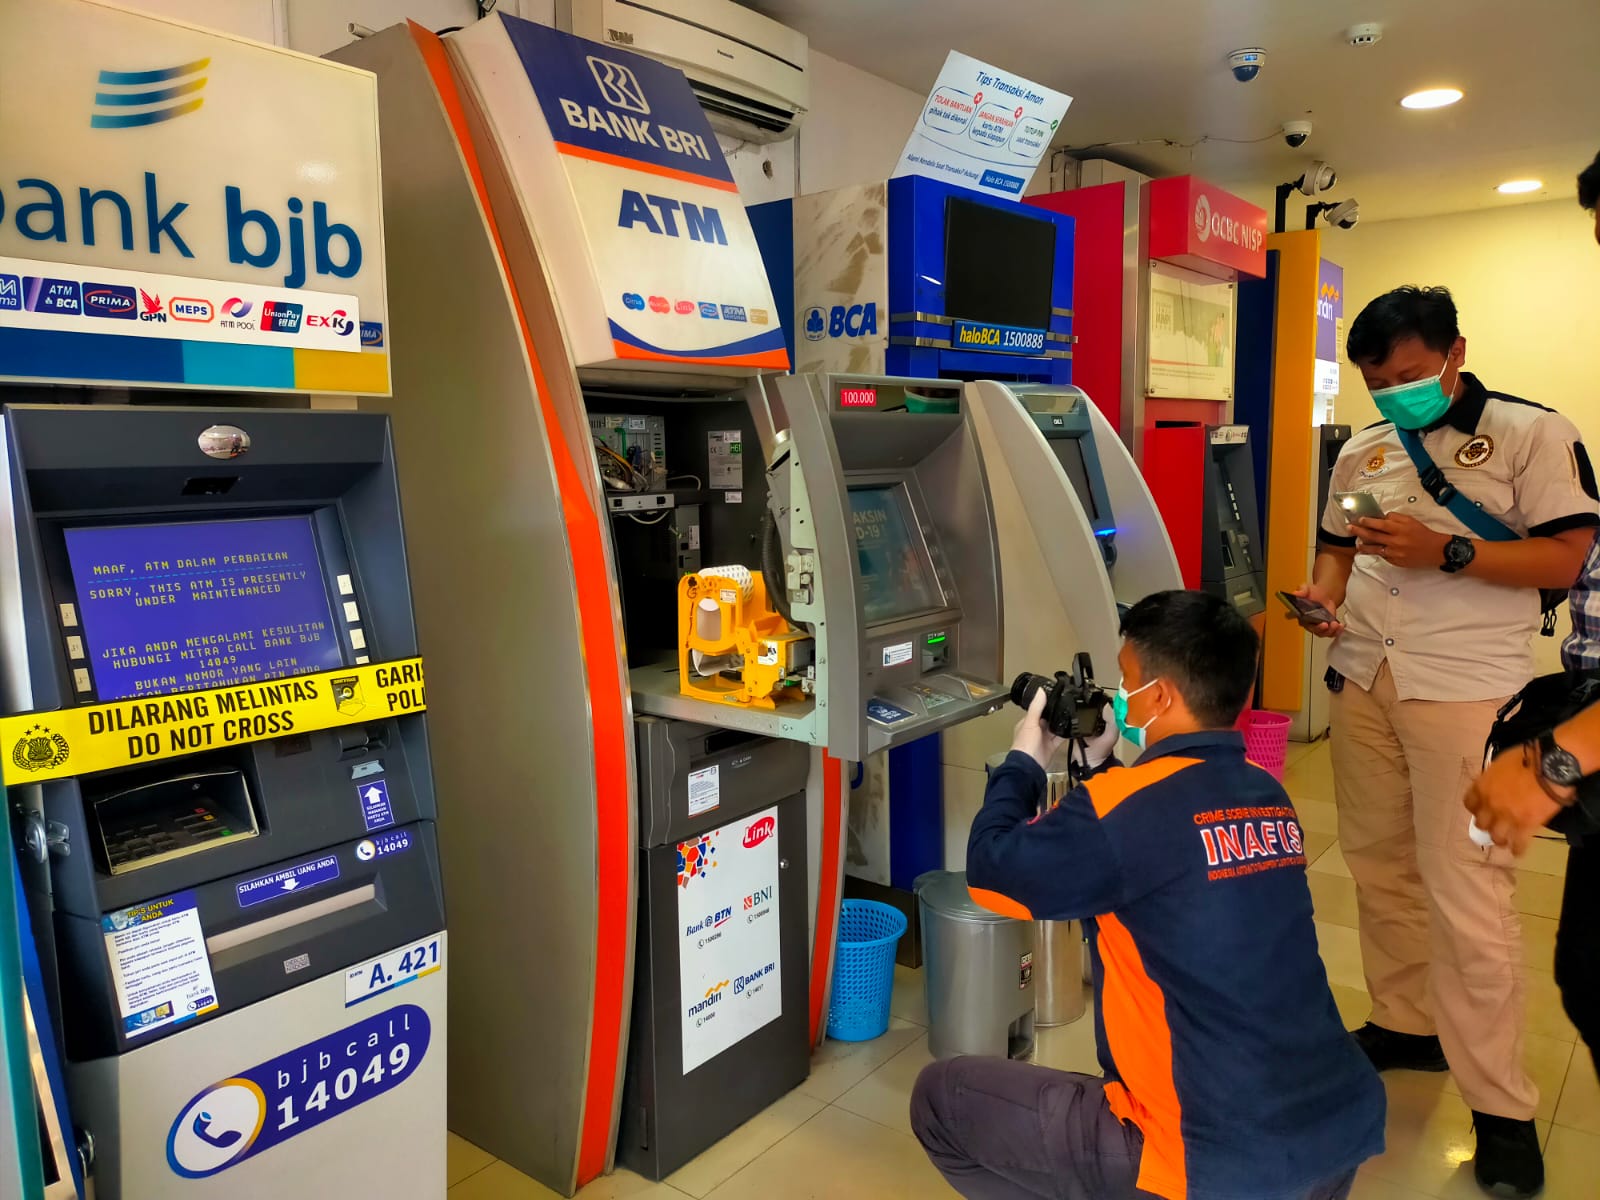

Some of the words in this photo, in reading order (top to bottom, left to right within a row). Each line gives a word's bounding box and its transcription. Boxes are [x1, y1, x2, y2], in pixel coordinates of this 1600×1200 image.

[976, 71, 993, 86] Tips
[993, 77, 1026, 98] Transaksi
[1024, 89, 1045, 105] Aman
[929, 106, 943, 117] pihak
[950, 114, 969, 125] dikenal
[935, 94, 951, 106] TOLAK
[950, 100, 973, 114] BANTUAN
[559, 97, 661, 149] BANK
[658, 124, 711, 161] BRI
[618, 188, 729, 246] ATM
[0, 171, 195, 259] ank
[225, 185, 362, 289] bjb
[1211, 211, 1239, 246] OCBC
[1241, 223, 1263, 254] NISP
[49, 284, 73, 296] ATM
[90, 295, 131, 308] PRIMA
[56, 298, 78, 309] BCA
[175, 303, 208, 317] MEPS
[264, 308, 300, 321] UnionPay
[140, 311, 168, 323] GPN
[828, 302, 877, 338] BCA
[959, 325, 1000, 346] haloBCA
[1003, 331, 1044, 349] 1500888
[843, 390, 874, 404] 100.000
[853, 509, 887, 525] AKSIN
[855, 524, 881, 540] D-19
[93, 563, 136, 576] MAAF,
[145, 560, 170, 571] ATM
[177, 557, 217, 569] DALAM
[223, 551, 289, 564] PERBAIKAN
[89, 587, 141, 600] SORRY,
[149, 582, 182, 594] THIS
[190, 579, 214, 590] ATM
[220, 577, 236, 588] IS
[242, 571, 307, 585] PRESENTLY
[135, 595, 177, 607] UNDER
[192, 584, 282, 602] MAINTENANCED
[102, 646, 137, 659] JIKA
[145, 640, 178, 653] ANDA
[186, 631, 254, 648] MENGALAMI
[262, 621, 325, 638] KESULITAN
[113, 653, 172, 670] HUBUNGI
[180, 646, 220, 660] MITRA
[227, 642, 257, 653] CALL
[264, 636, 293, 649] BANK
[299, 633, 321, 645] BJB
[135, 676, 177, 691] BUKAN
[185, 670, 224, 682] NOMOR
[231, 663, 261, 675] YANG
[268, 657, 298, 669] LAIN
[199, 656, 237, 668] 14049
[375, 662, 424, 689] GARI
[88, 696, 210, 735] DILARANG
[216, 679, 319, 715] MELINTAS
[127, 735, 163, 760] DO
[169, 722, 223, 750] NOT
[227, 710, 295, 740] CROSS
[1193, 809, 1225, 825] CRIME
[1225, 807, 1250, 820] SCENE
[744, 820, 774, 844] Link
[1200, 820, 1303, 866] INAFIS
[377, 839, 408, 855] 14049
[239, 877, 274, 894] SILAHKAN
[275, 871, 297, 883] AMBIL
[297, 864, 316, 876] UANG
[316, 858, 335, 870] ANDA
[147, 899, 174, 912] UNTUK
[753, 885, 773, 906] BNI
[141, 911, 164, 921] ANDA
[686, 921, 704, 936] Bank
[714, 906, 732, 923] BTN
[369, 963, 393, 989] A.
[398, 941, 439, 974] 421
[745, 969, 764, 985] BANK
[764, 962, 775, 976] BRI
[346, 1013, 410, 1057] call
[277, 1043, 410, 1131] 14049
